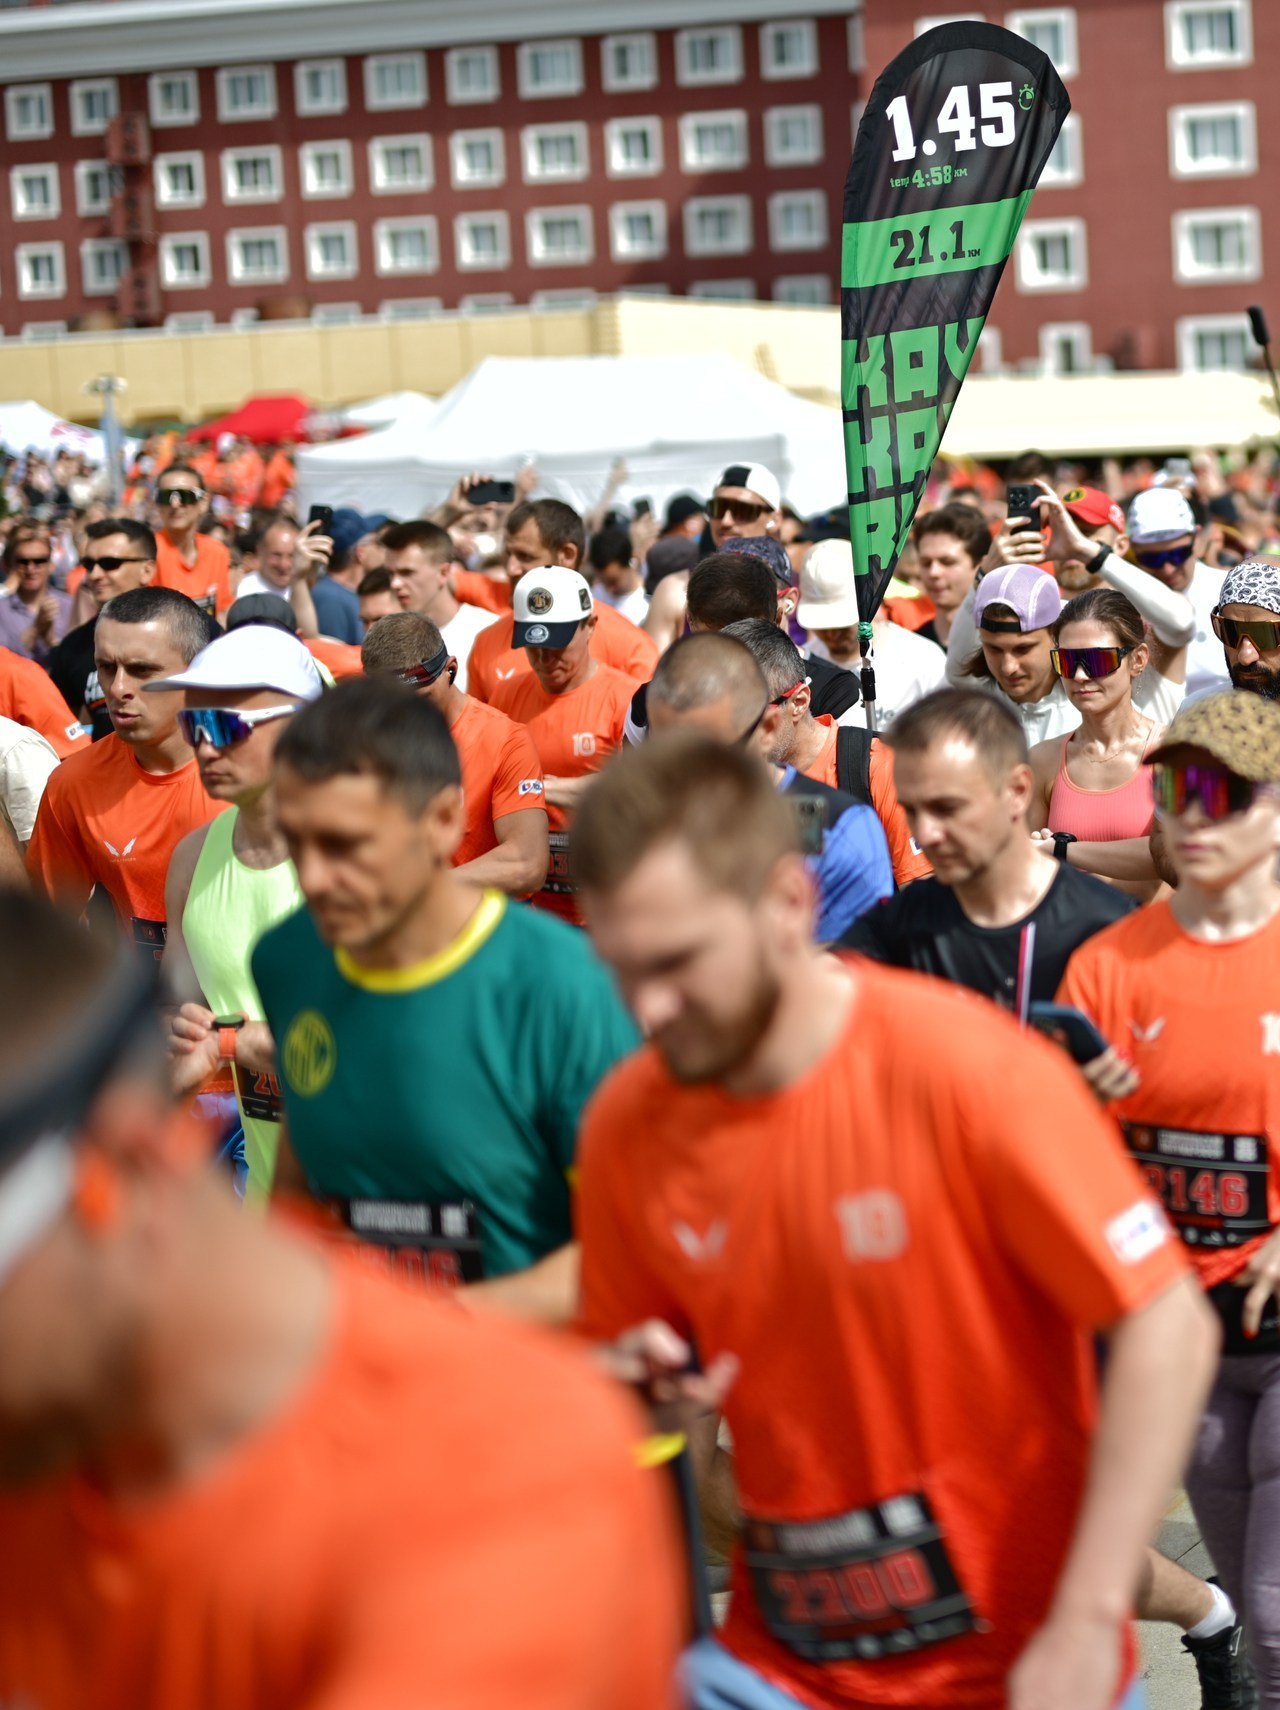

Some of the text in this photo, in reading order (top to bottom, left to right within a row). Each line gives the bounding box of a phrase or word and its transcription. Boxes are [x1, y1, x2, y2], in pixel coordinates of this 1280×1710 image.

[885, 81, 1016, 162] 1.45
[911, 165, 952, 188] 4:58
[890, 220, 966, 269] 21.1
[572, 732, 596, 757] 10
